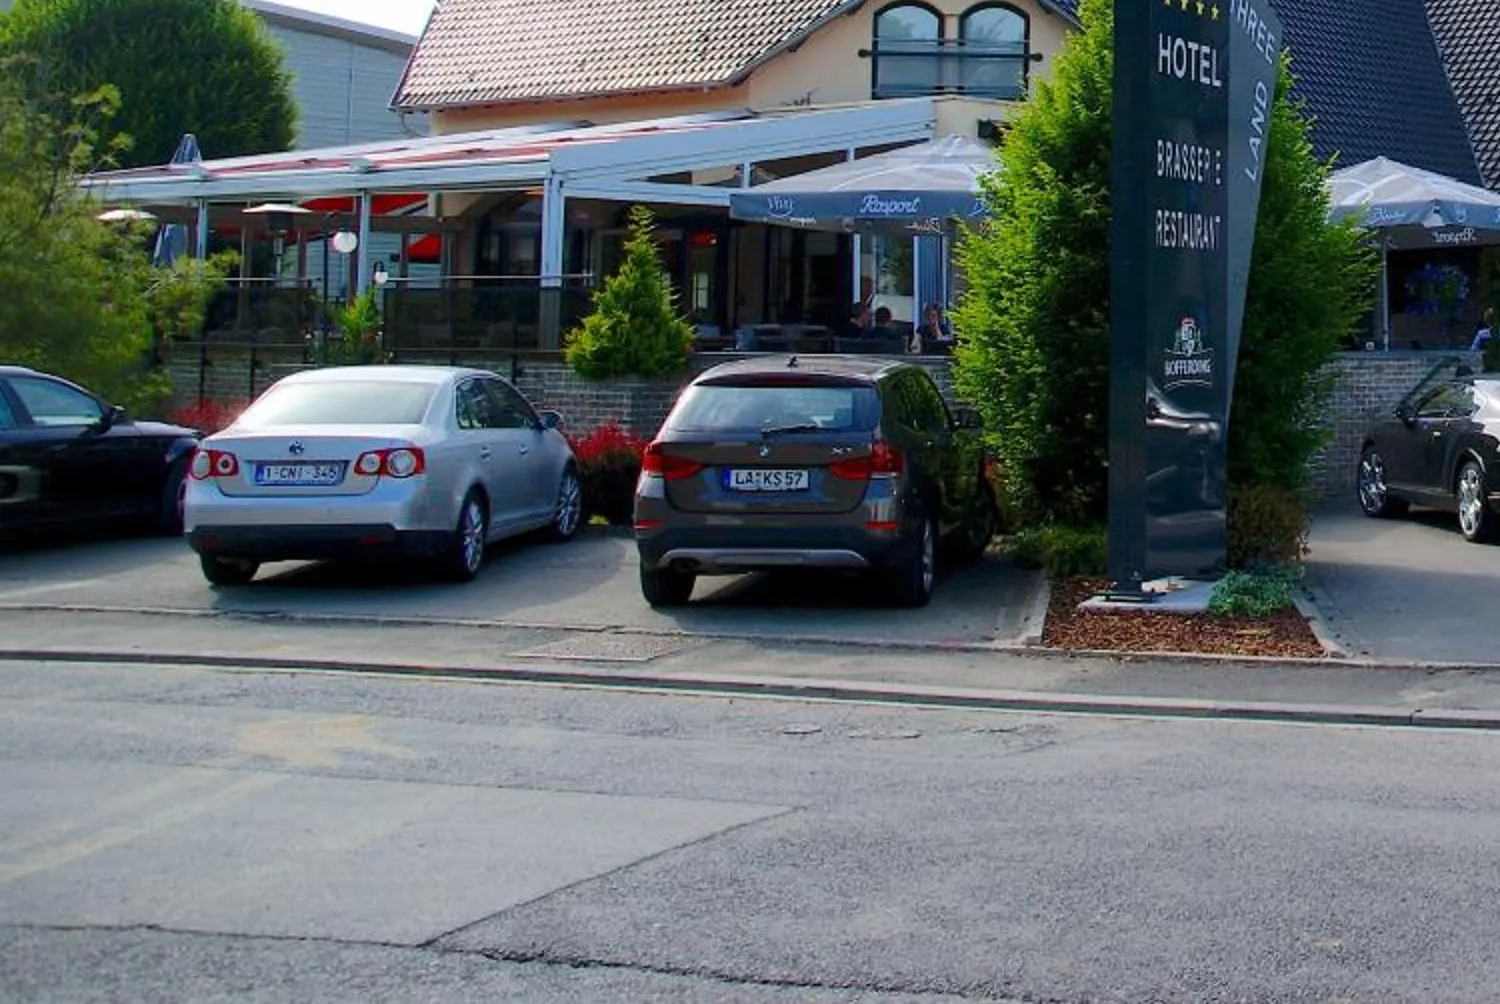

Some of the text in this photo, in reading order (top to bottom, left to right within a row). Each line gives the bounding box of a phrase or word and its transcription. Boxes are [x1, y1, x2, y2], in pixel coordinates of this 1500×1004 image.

[1158, 32, 1222, 87] HOTEL
[1244, 80, 1268, 182] LAND
[1157, 139, 1221, 185] BRASSERIE
[860, 195, 919, 216] Rosport
[1156, 209, 1221, 251] RESTAURANT
[735, 471, 753, 485] LA
